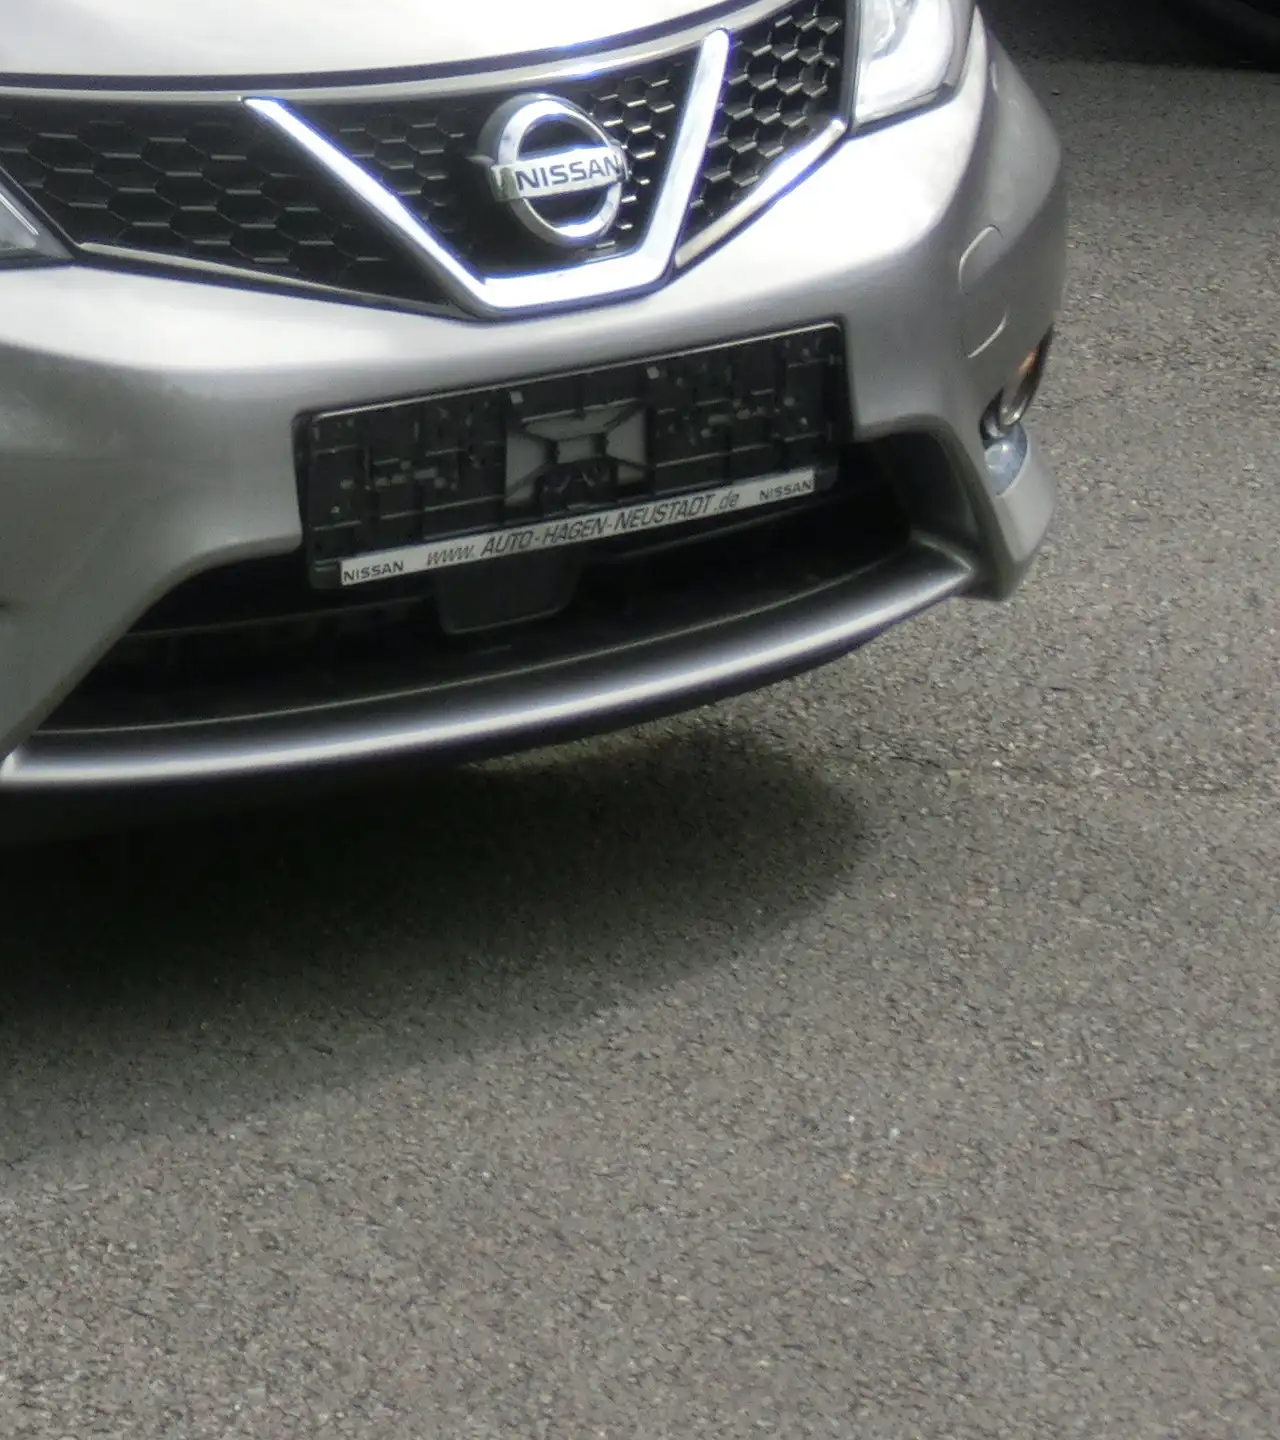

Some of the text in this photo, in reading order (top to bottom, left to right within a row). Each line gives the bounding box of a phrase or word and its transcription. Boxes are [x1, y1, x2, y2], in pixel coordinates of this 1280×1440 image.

[516, 154, 625, 191] NISSAN
[343, 560, 404, 582] NISSAN
[760, 479, 814, 501] NISSAN
